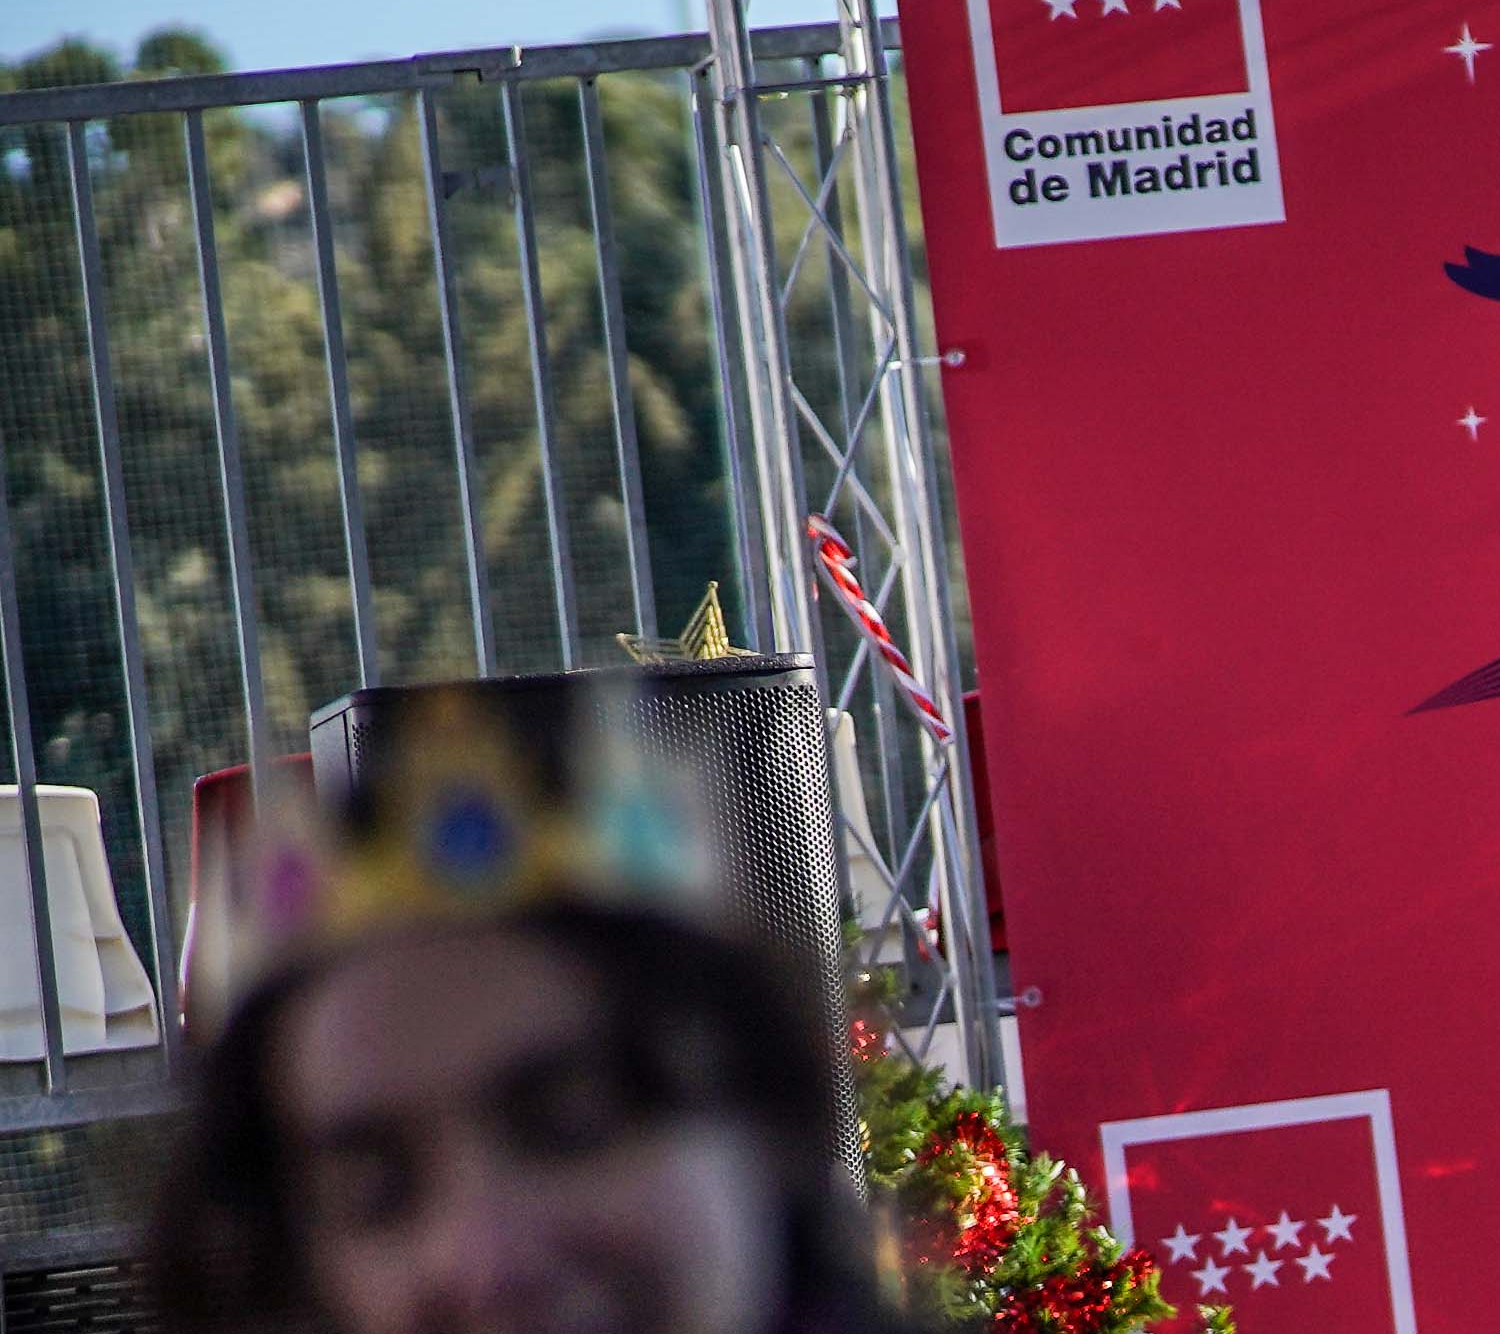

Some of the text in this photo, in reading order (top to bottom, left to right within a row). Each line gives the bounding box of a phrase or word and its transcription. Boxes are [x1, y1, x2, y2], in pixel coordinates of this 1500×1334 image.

[1003, 108, 1258, 161] Comunidad
[1008, 147, 1261, 205] de Madrid
